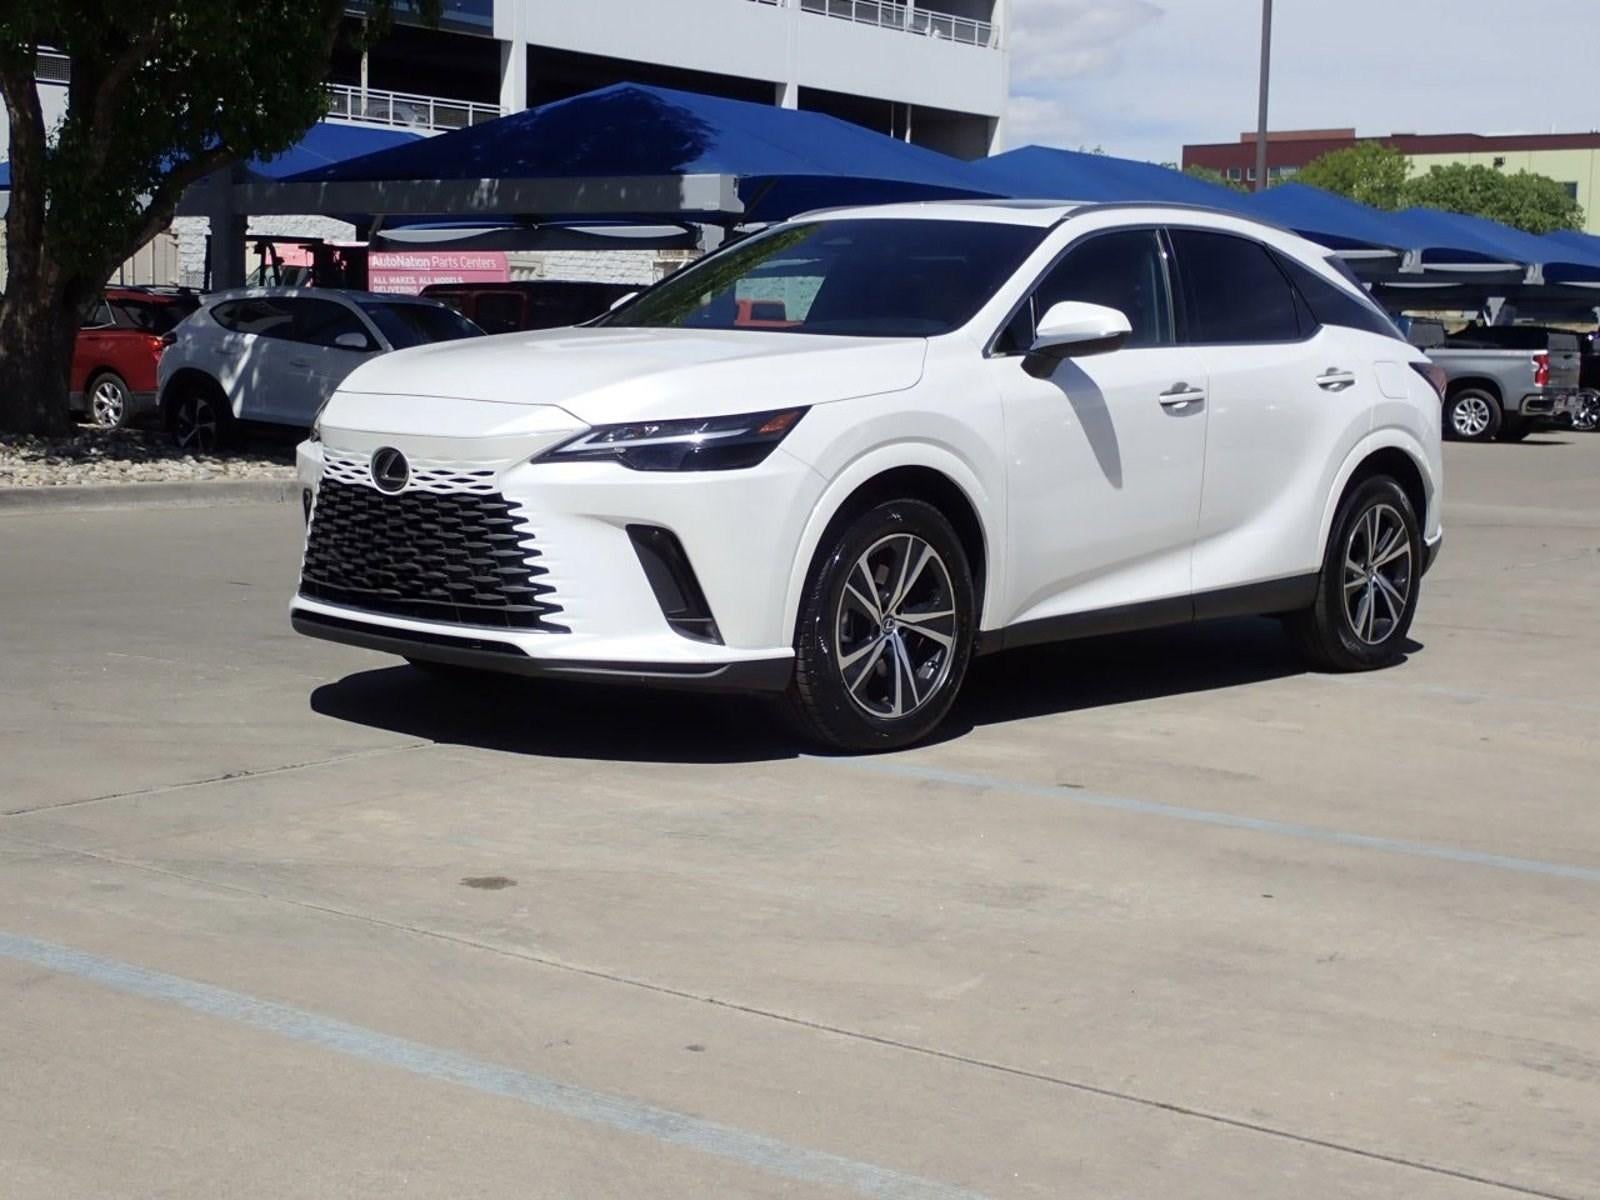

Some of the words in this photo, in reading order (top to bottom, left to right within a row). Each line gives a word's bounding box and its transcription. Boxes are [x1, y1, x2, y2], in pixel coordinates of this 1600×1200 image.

[372, 255, 430, 267] AutoNation
[432, 255, 457, 268] Parts
[460, 256, 497, 269] Centers
